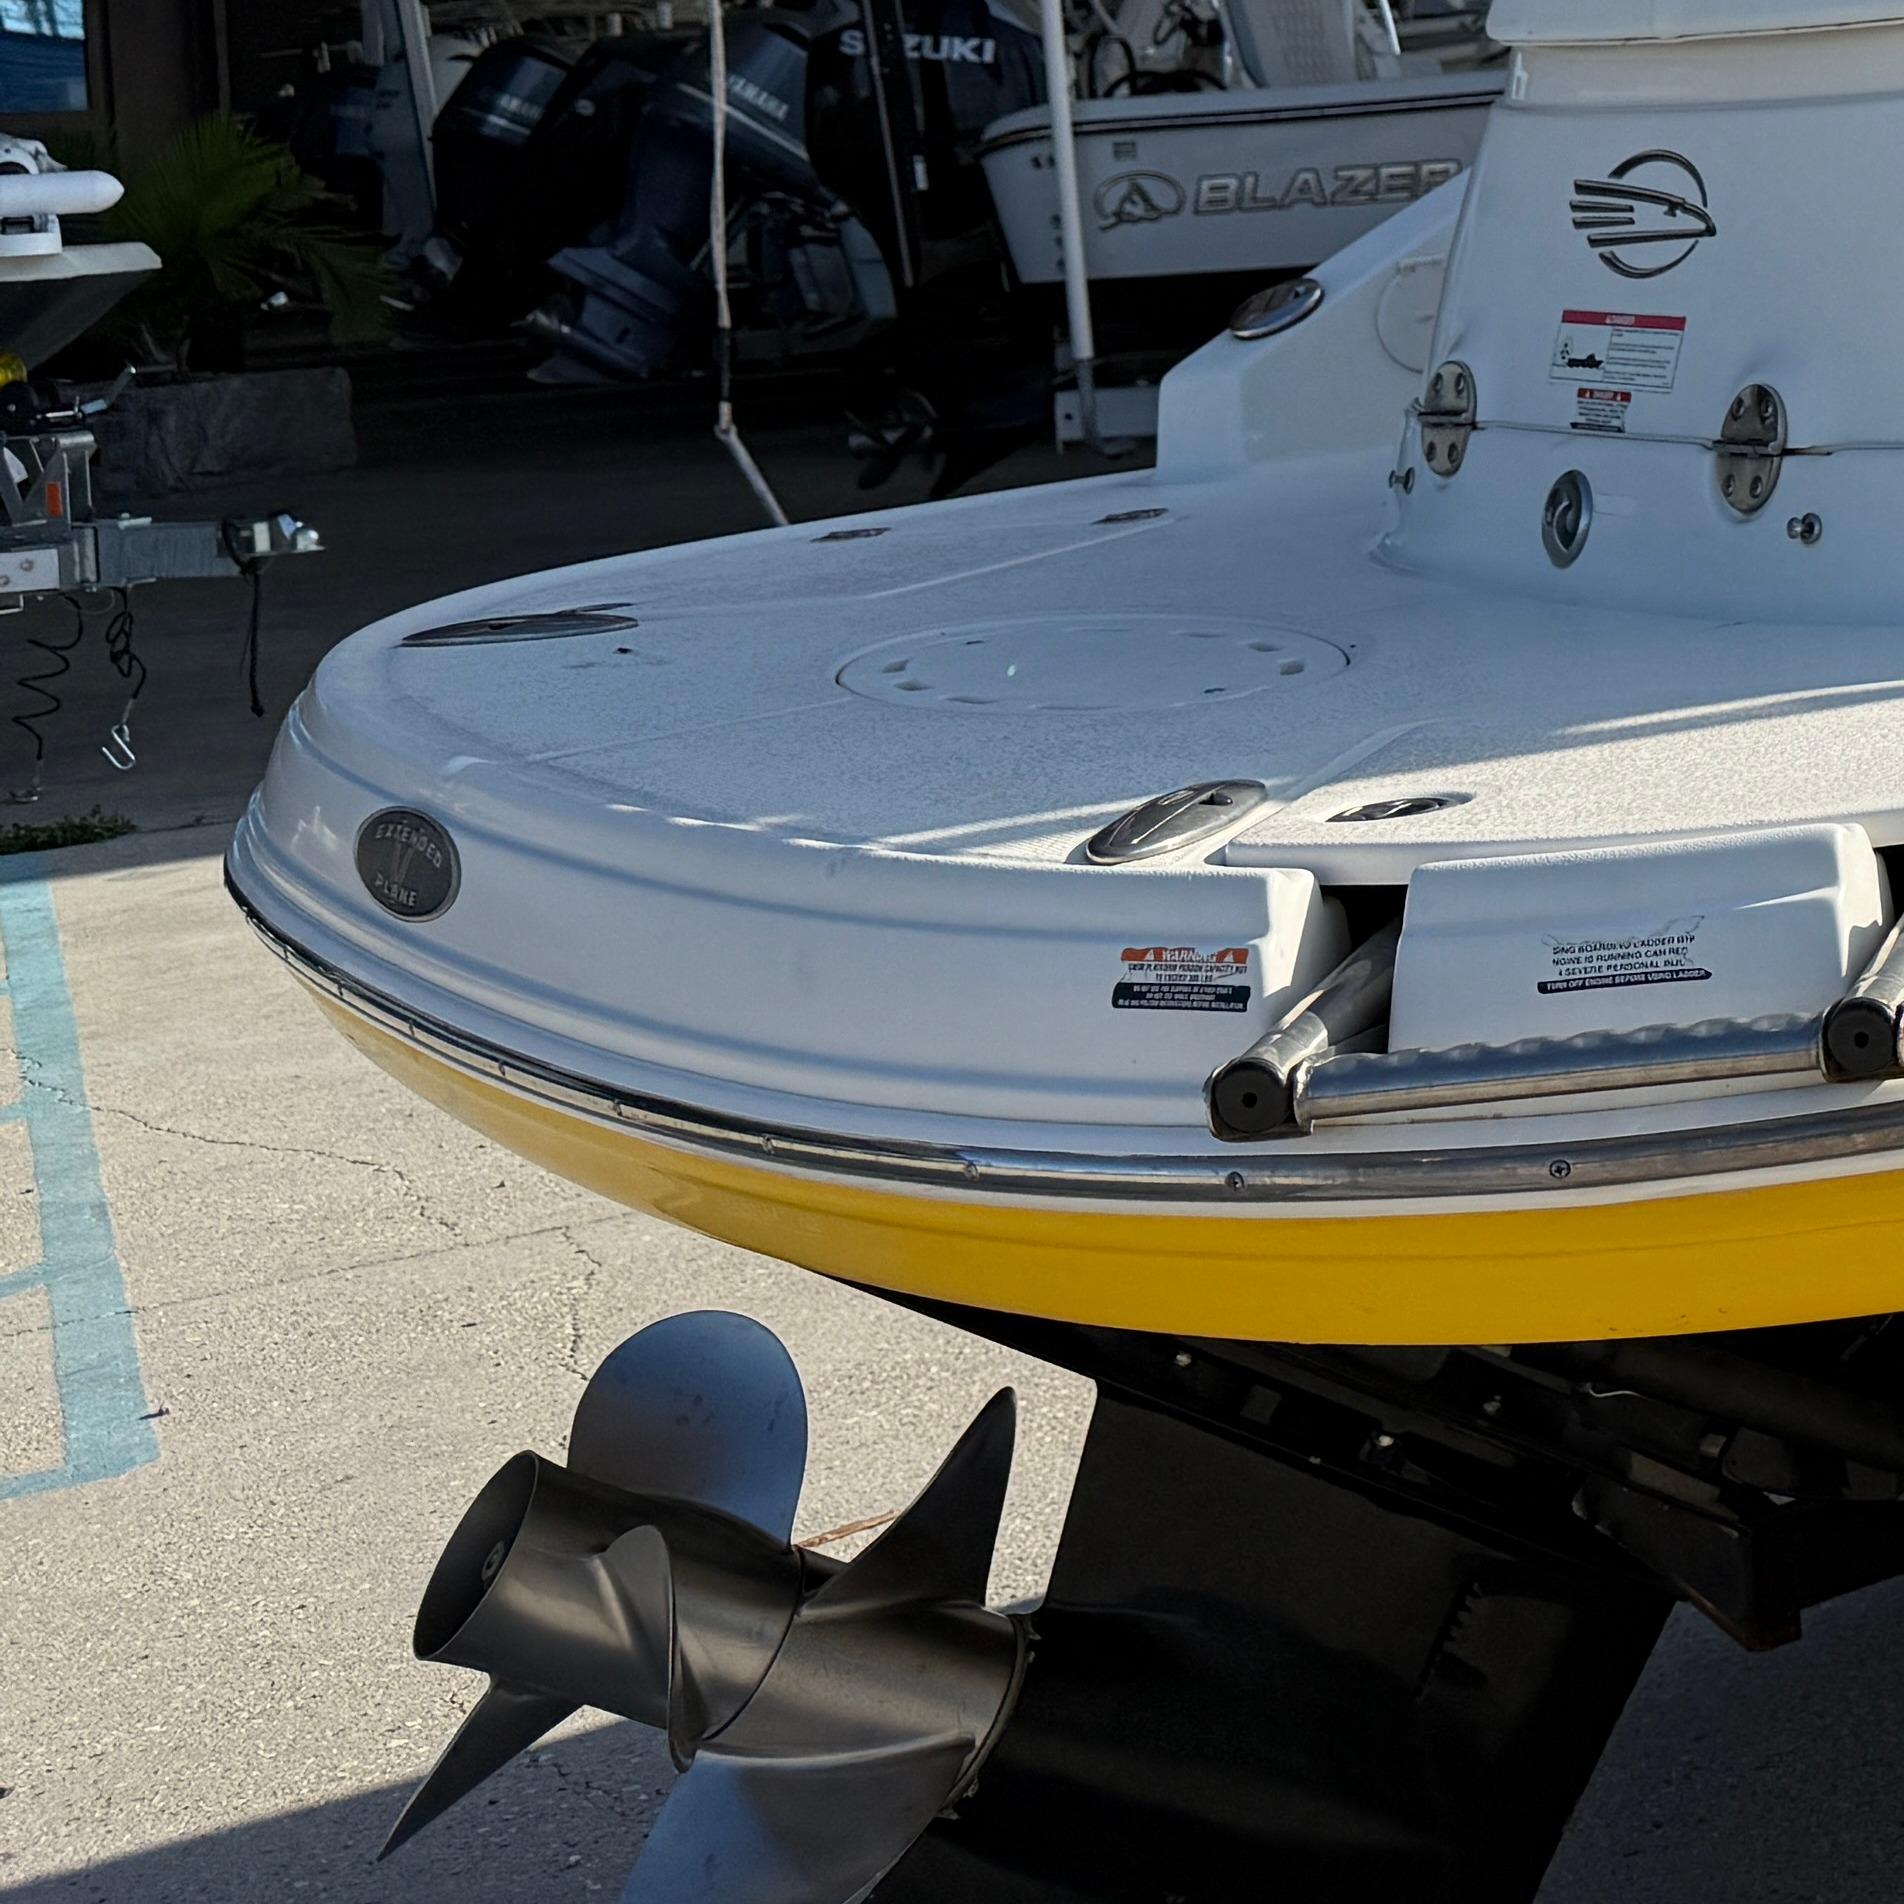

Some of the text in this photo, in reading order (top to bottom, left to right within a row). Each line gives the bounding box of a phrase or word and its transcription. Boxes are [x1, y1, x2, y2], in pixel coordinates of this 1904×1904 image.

[838, 29, 996, 65] SZUKI
[375, 818, 442, 869] EXTENDED
[373, 870, 418, 906] PLANE
[1596, 950, 1642, 963] RUNNING
[1645, 948, 1667, 958] CAN
[1633, 935, 1675, 949] LADDER
